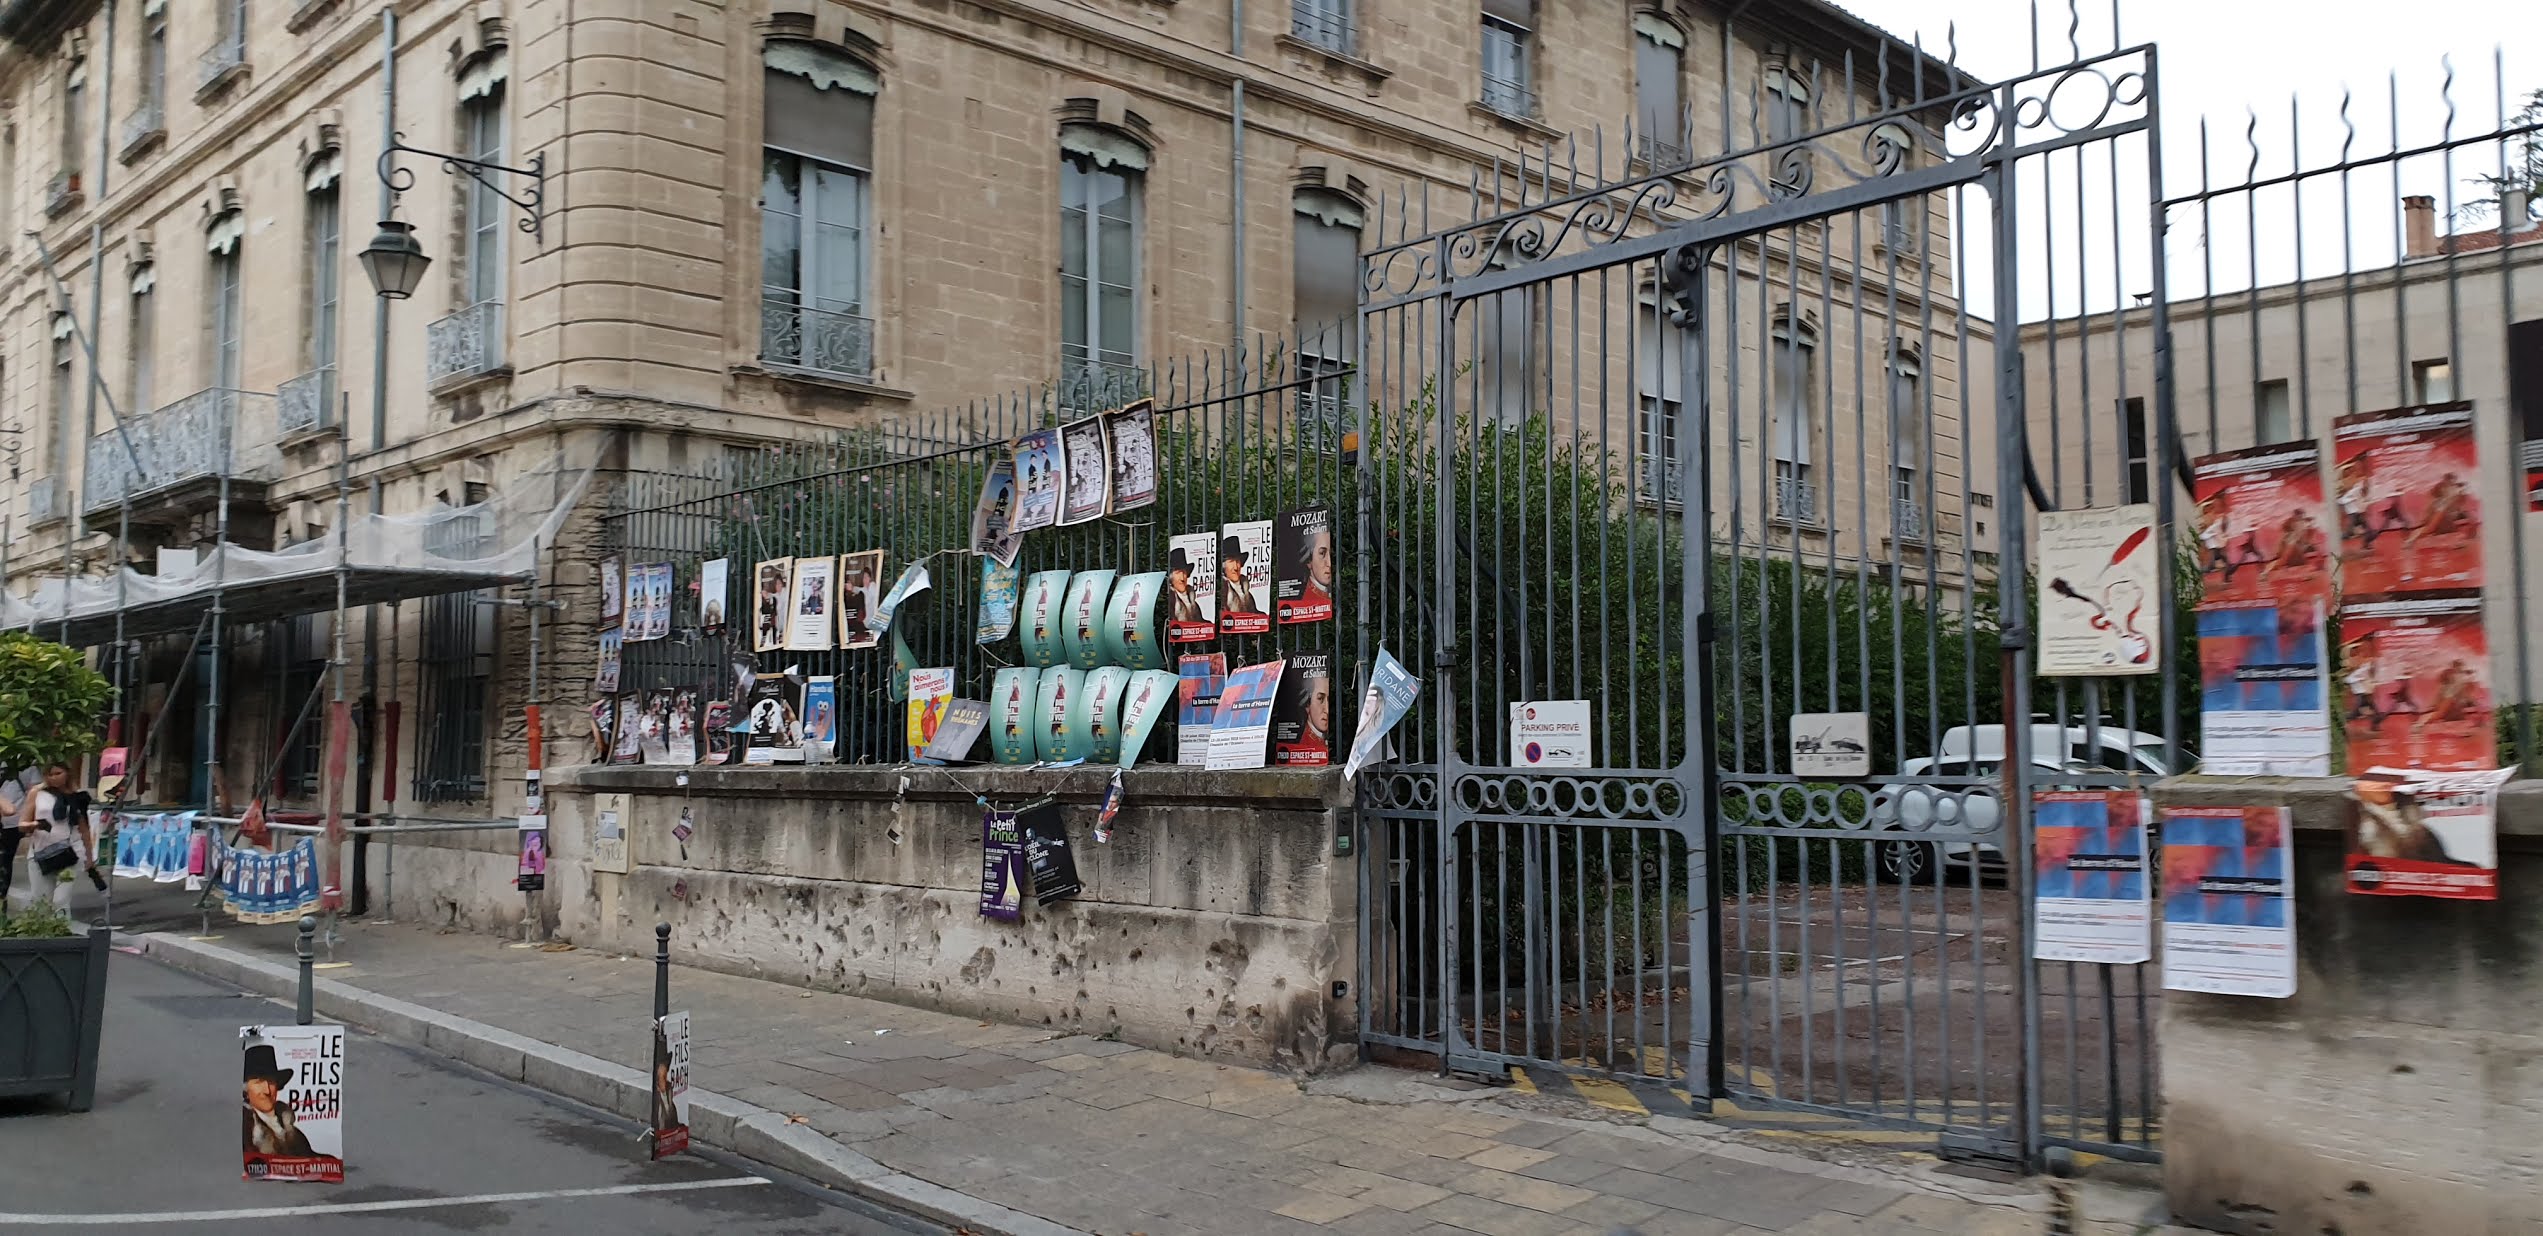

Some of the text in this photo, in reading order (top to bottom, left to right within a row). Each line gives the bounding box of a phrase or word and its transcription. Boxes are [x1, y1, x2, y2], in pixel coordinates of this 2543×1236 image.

[1291, 510, 1328, 528] MOZART
[1262, 526, 1270, 544] LE
[1303, 522, 1328, 536] et Salieri
[1206, 538, 1215, 554] LE
[1252, 546, 1270, 563] FILS
[1198, 556, 1214, 574] FILS
[1246, 564, 1270, 582] BACH
[1192, 575, 1214, 592] BACH
[1292, 655, 1328, 668] MOZART
[912, 674, 932, 683] Nous
[1303, 668, 1327, 678] et Salieri
[914, 678, 944, 690] aimerons
[990, 819, 1016, 832] Le Petit
[990, 828, 1018, 842] Prince
[680, 1018, 688, 1039] LE
[320, 1035, 342, 1058] LE
[674, 1042, 688, 1066] FILS
[300, 1062, 340, 1085] FILS
[670, 1066, 688, 1089] BACH
[289, 1088, 340, 1112] BACH
[270, 1164, 294, 1174] ESPACE
